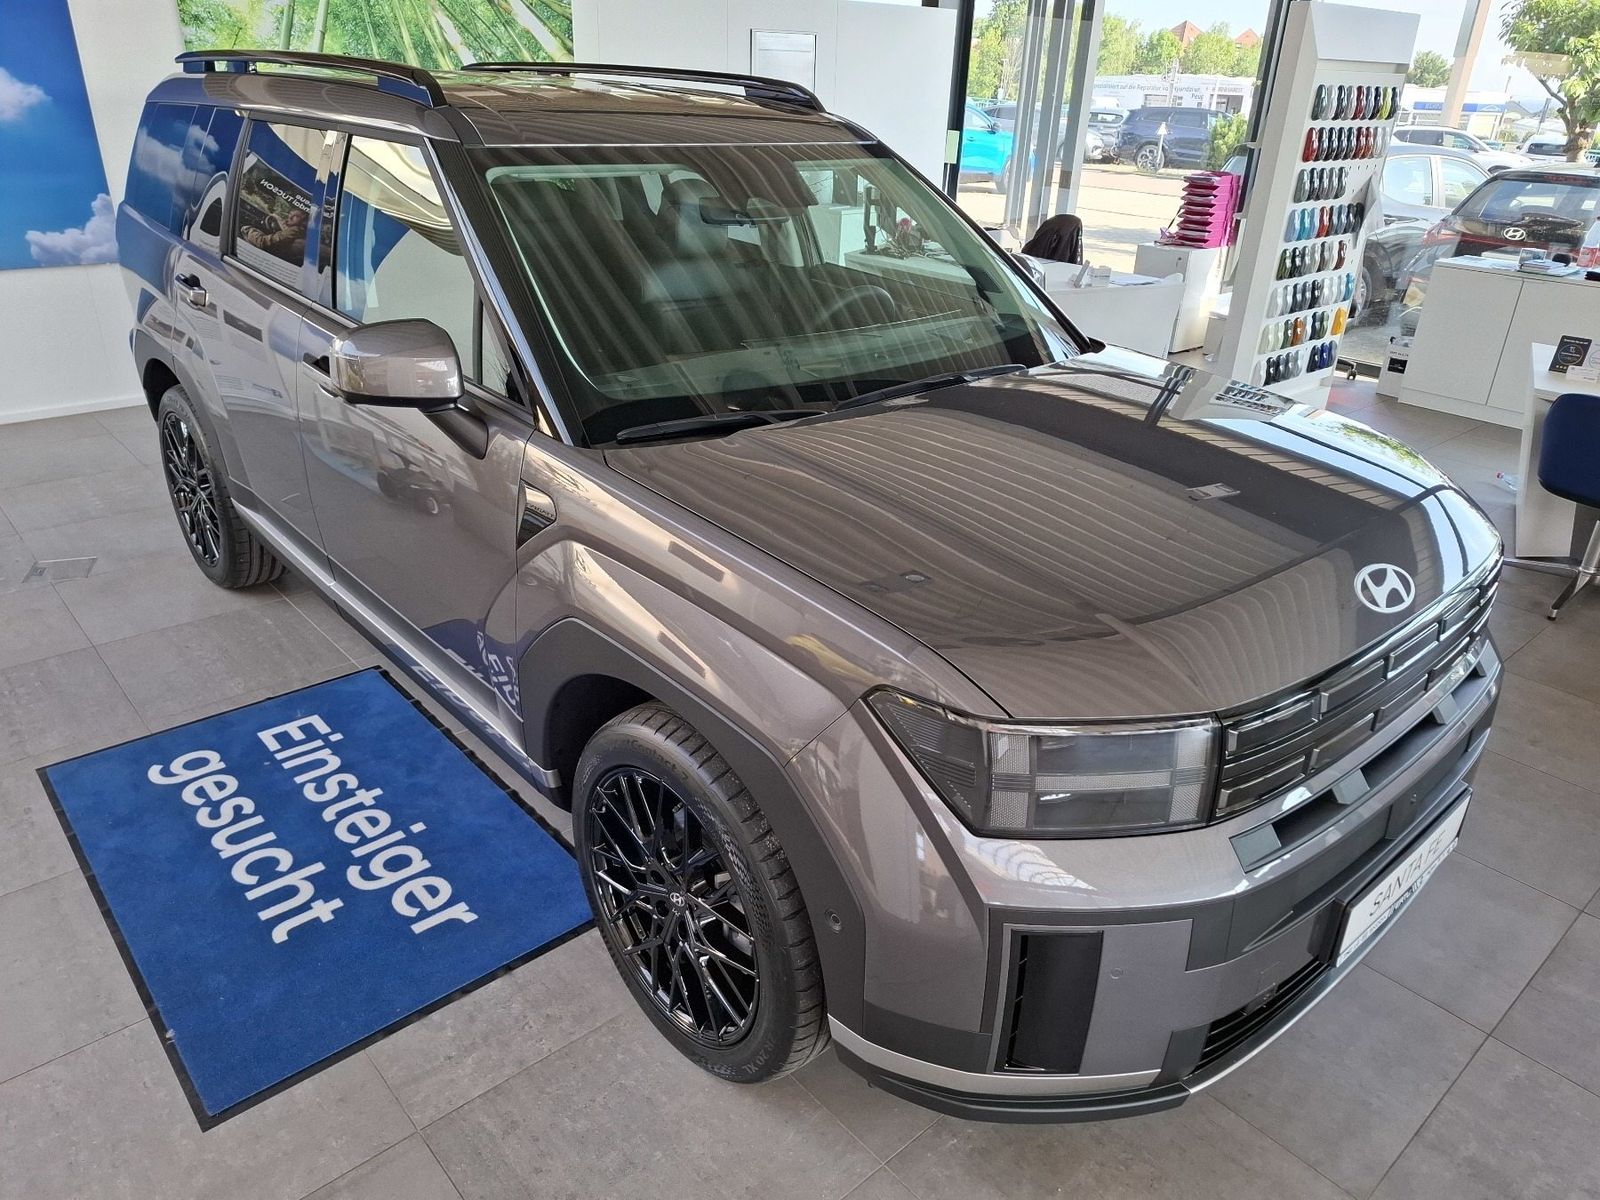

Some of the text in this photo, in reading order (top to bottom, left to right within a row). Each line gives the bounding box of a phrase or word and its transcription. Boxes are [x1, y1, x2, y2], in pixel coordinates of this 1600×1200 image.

[148, 749, 344, 945] gesucht
[257, 713, 479, 935] Einsteiger
[1369, 853, 1423, 916] SANTA
